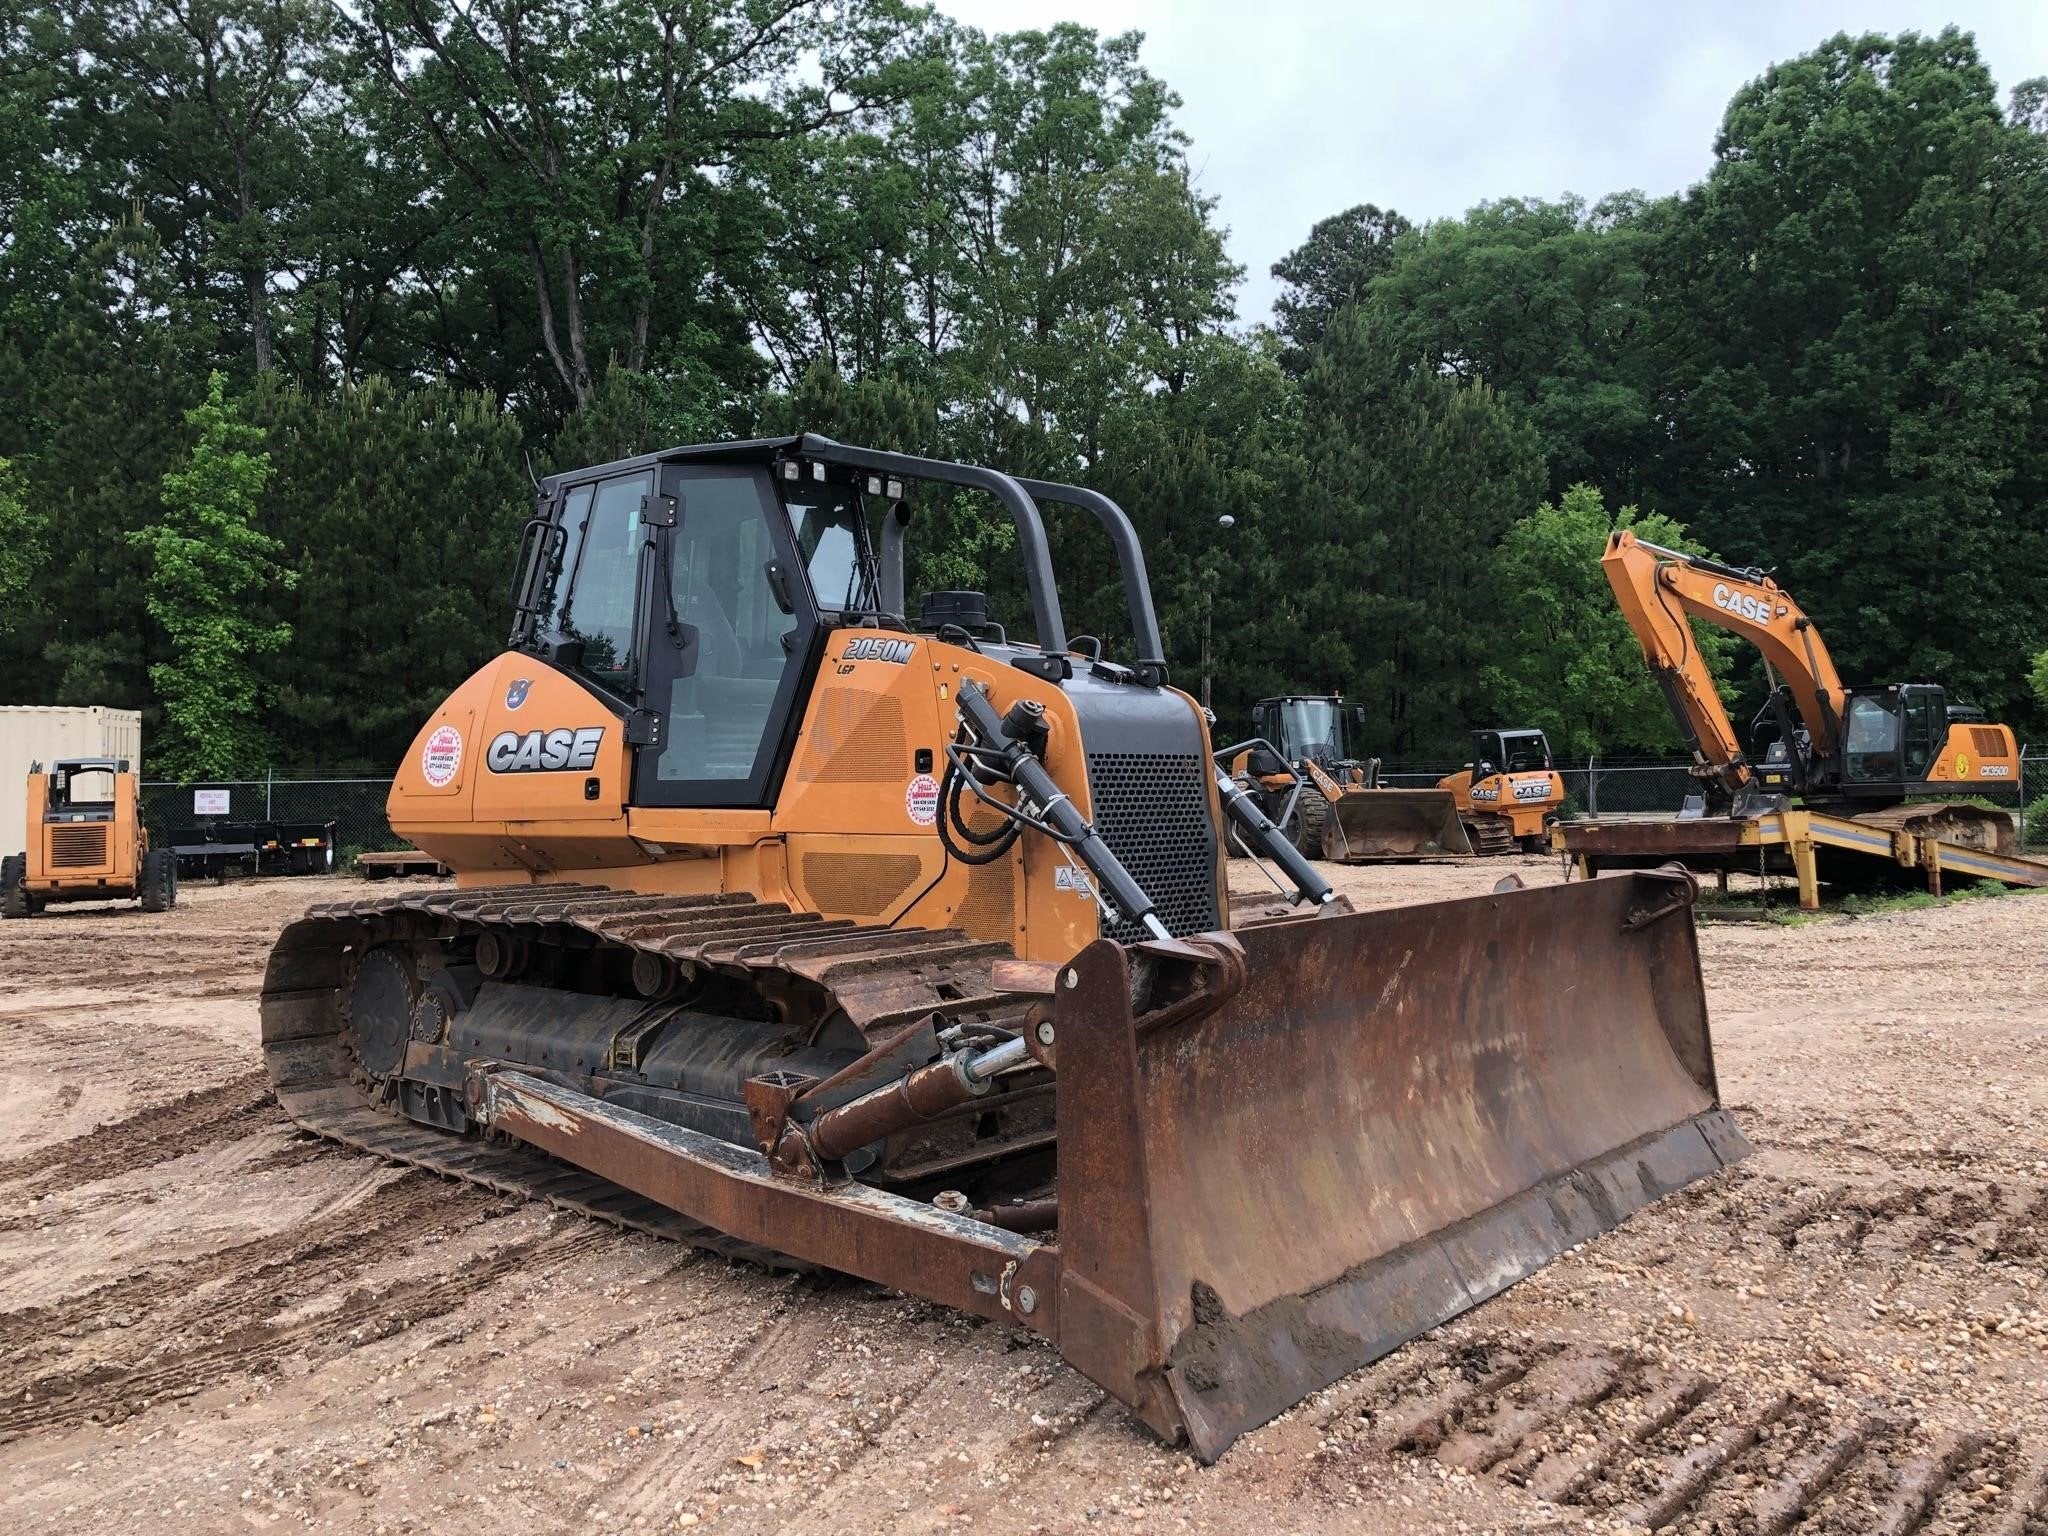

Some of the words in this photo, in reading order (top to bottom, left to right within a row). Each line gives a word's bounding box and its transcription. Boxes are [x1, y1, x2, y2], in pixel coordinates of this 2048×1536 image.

[1713, 583, 1771, 626] CASE
[842, 637, 916, 665] 2050M
[837, 664, 855, 675] LGP
[487, 727, 605, 773] CASE
[1312, 770, 1334, 793] CASE
[1514, 785, 1552, 799] CASE
[1471, 789, 1498, 801] CASE
